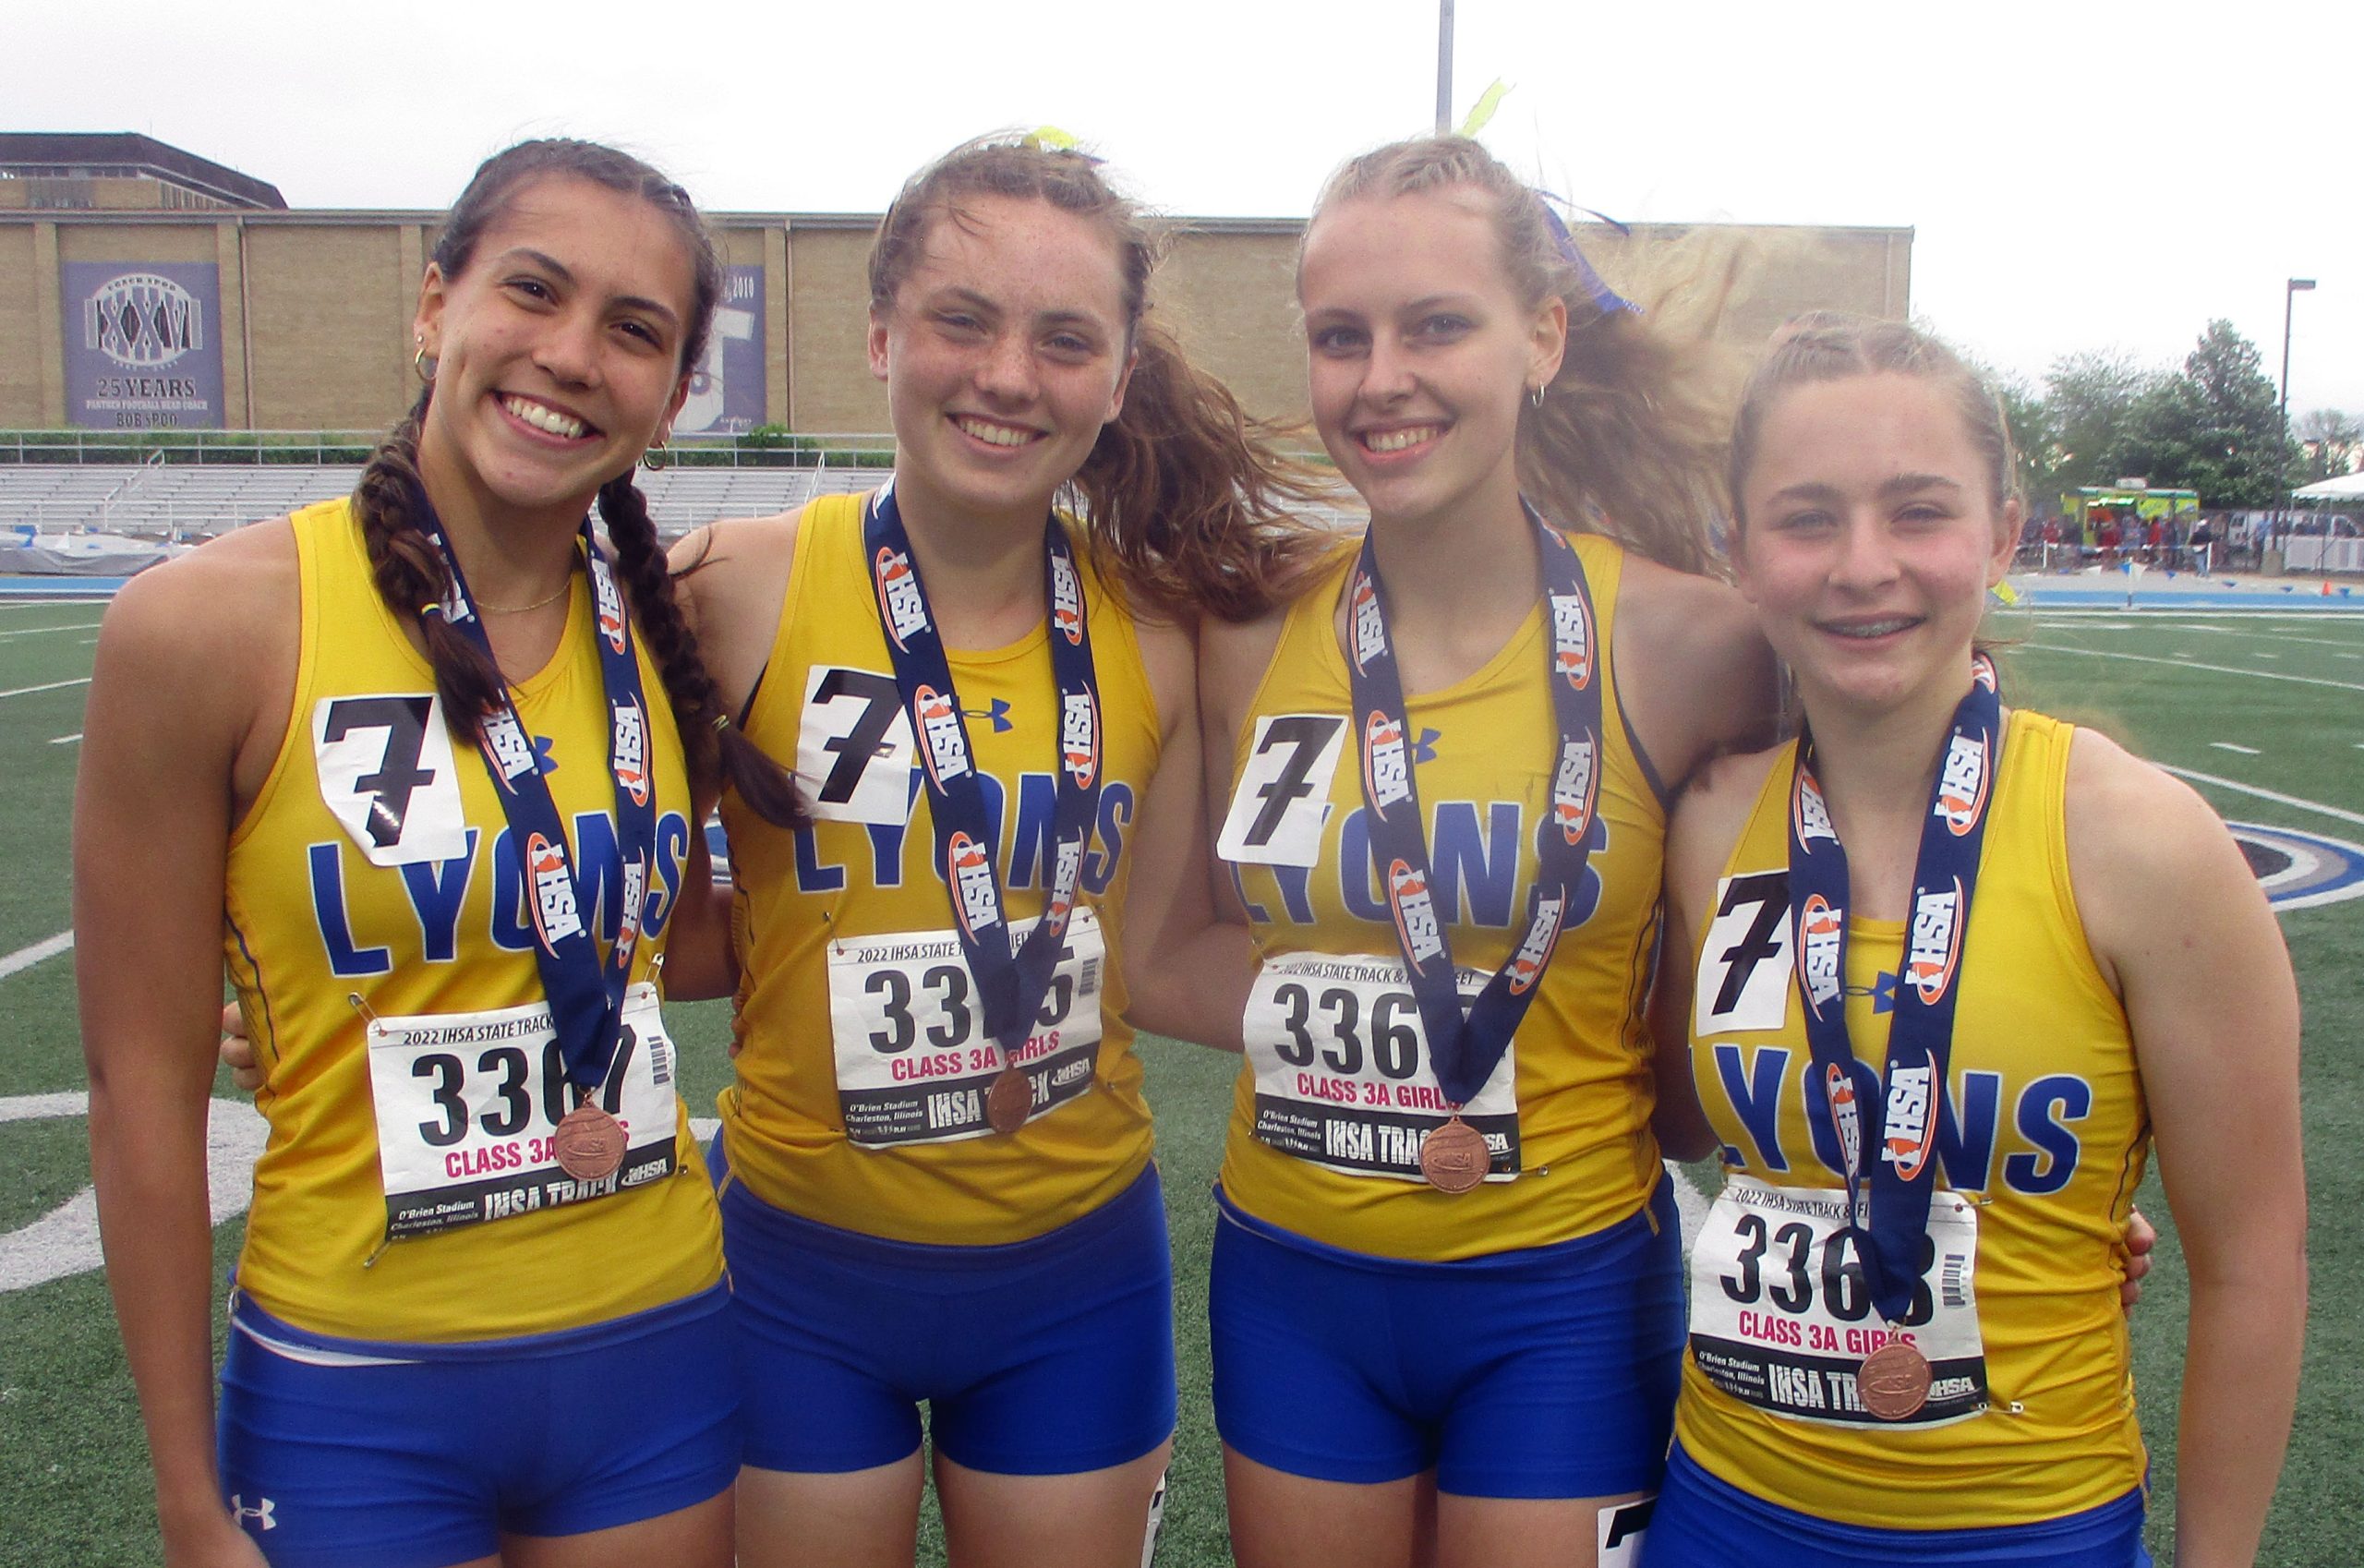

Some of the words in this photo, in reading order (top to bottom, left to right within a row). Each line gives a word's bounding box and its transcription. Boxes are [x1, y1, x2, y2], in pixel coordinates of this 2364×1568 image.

[733, 276, 754, 298] 2010
[98, 379, 121, 397] 25
[126, 379, 196, 397] YEARS
[116, 413, 142, 428] BOB
[146, 413, 177, 428] SPOO
[879, 552, 927, 640] IHSA
[1551, 593, 1587, 680] IHSA
[323, 695, 436, 848] 7
[481, 706, 536, 780] HSA
[614, 706, 644, 797] IHSA
[812, 669, 906, 804] 7
[919, 694, 969, 782] IHSA
[1064, 694, 1092, 780] IHSA
[1369, 718, 1411, 807] IHSA
[1244, 718, 1345, 847] 7
[1554, 742, 1592, 832] IHSA
[1801, 772, 1837, 838] HSA
[1934, 736, 1986, 825] IHSA
[532, 843, 583, 944] IHSA
[953, 841, 998, 932] IHSA
[1393, 869, 1442, 962] IHSA
[858, 948, 887, 963] 2022
[890, 946, 920, 960] IHSA
[922, 943, 956, 958] STATE
[1300, 962, 1322, 977] IHSA
[1323, 964, 1351, 980] STATE
[1353, 967, 1391, 983] TRACK
[1393, 970, 1404, 983] &
[1712, 871, 1791, 1015] 7
[1805, 906, 1841, 1007] IHSA
[1905, 890, 1956, 992] IHSA
[404, 1031, 439, 1045] 2022
[442, 1028, 474, 1043] IHSA
[477, 1022, 515, 1041] STATE
[517, 1015, 554, 1035] TRACK
[864, 946, 1075, 1054] 335
[1272, 983, 1478, 1080] 336
[412, 1024, 637, 1147] 3367
[891, 1050, 962, 1081] CLASS
[970, 1046, 997, 1070] 3A
[1297, 1073, 1357, 1104] CLASS
[1364, 1082, 1391, 1105] 3A
[883, 1100, 918, 1111] Stadium
[894, 1109, 923, 1121] Illinois
[927, 1089, 983, 1130] IHSA
[1289, 1115, 1318, 1128] Stadium
[1689, 1044, 2093, 1195] YONS
[1881, 1066, 1931, 1166] IHSA
[445, 1141, 522, 1178] CLASS
[1325, 1118, 1374, 1162] IHSA
[1378, 1122, 1431, 1165] TRA
[399, 1207, 434, 1220] O'Brien
[436, 1200, 475, 1215] Stadium
[447, 1211, 478, 1223] Illinois
[485, 1184, 540, 1221] IHSA
[1735, 1188, 1761, 1205] 2022
[1761, 1189, 1785, 1209] IHSA
[1811, 1201, 1839, 1219] TRACK
[1728, 1357, 1759, 1372] Stadium
[1739, 1310, 1802, 1346] CLASS
[1809, 1324, 1839, 1352] 3A
[1846, 1328, 1917, 1355] GIRS
[1737, 1371, 1765, 1385] Illinois
[1768, 1363, 1825, 1408] IHSA
